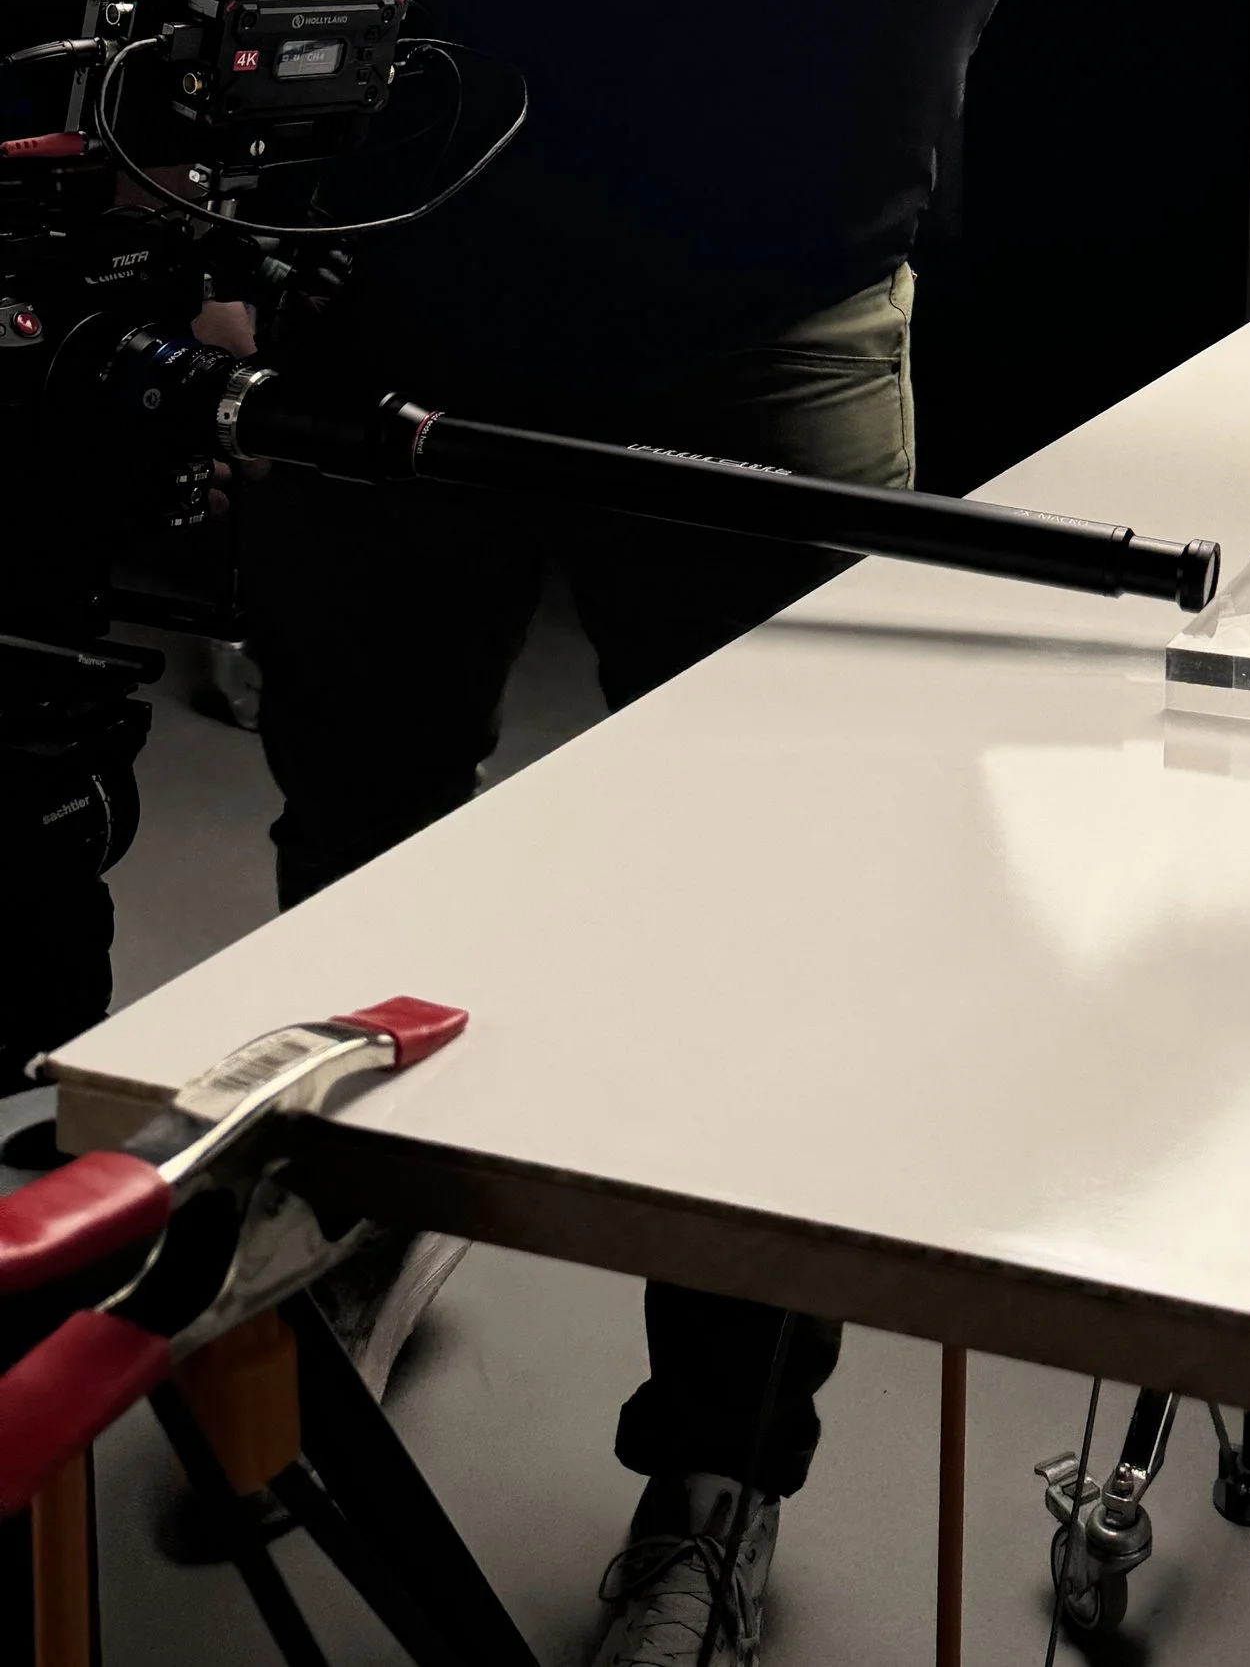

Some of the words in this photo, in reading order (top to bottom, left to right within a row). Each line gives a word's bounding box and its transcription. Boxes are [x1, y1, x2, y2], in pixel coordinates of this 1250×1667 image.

[305, 15, 348, 25] HOLLYLAND
[237, 52, 257, 67] 4K
[112, 250, 150, 269] TILTA
